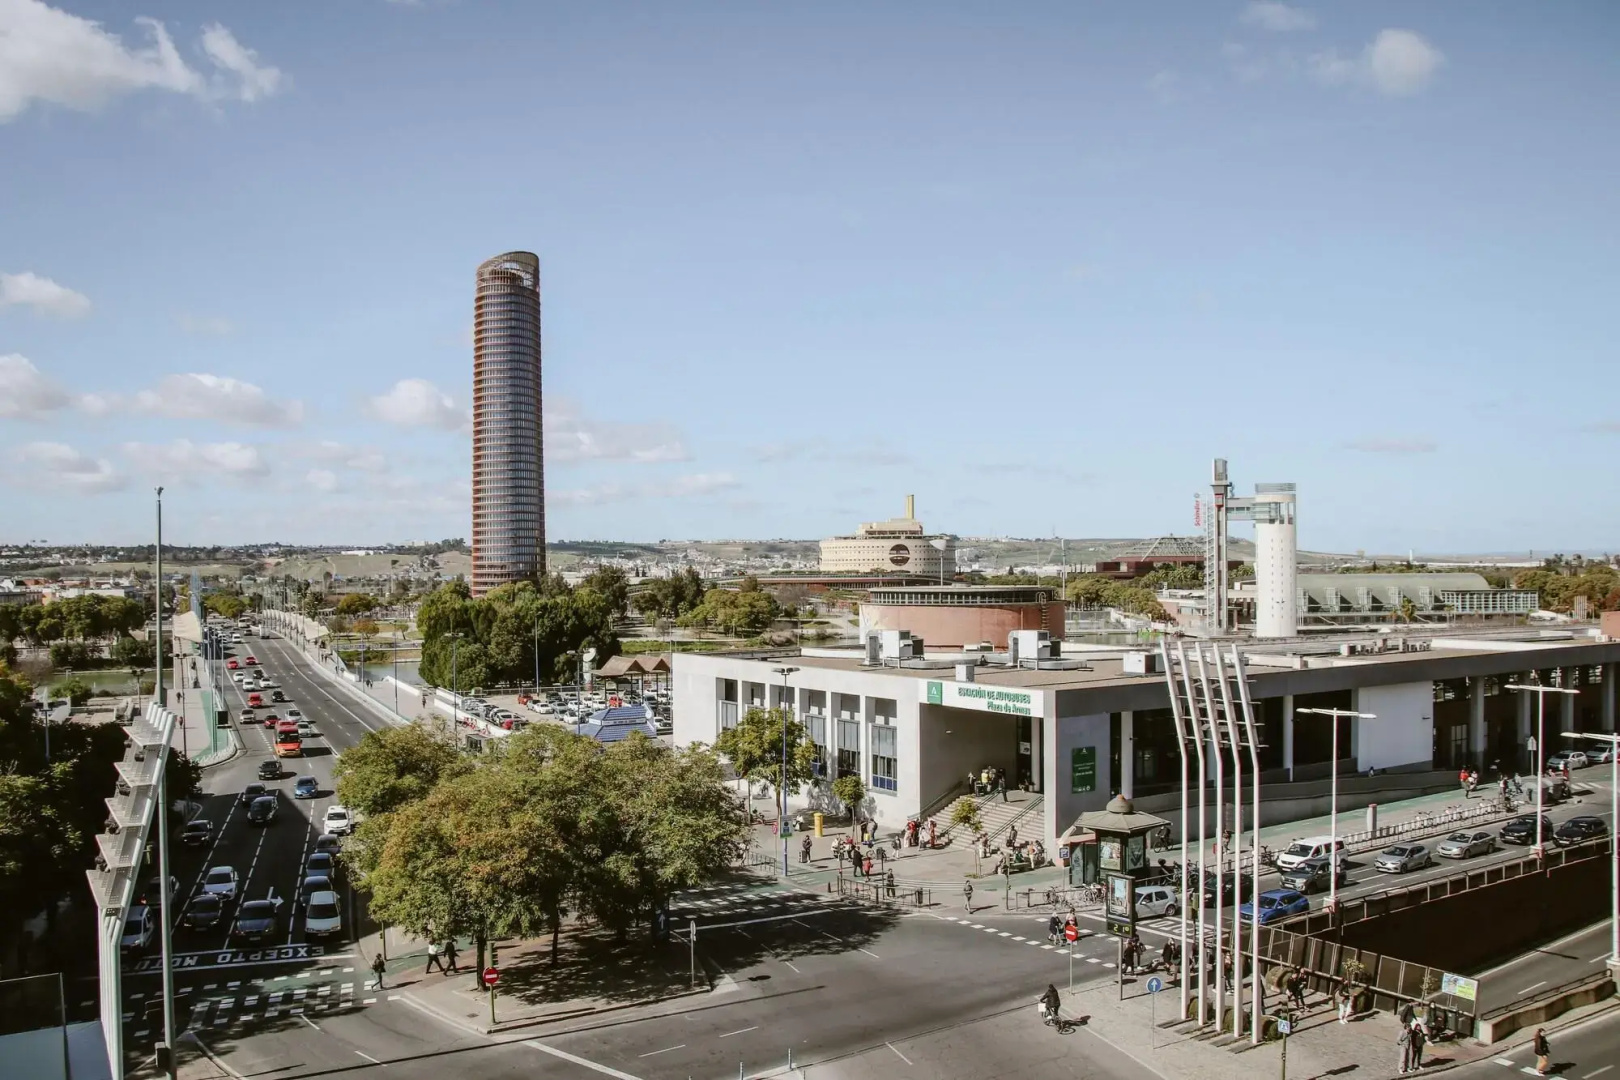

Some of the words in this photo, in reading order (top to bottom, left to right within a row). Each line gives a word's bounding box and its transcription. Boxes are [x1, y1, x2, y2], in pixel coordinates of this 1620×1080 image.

[987, 690, 995, 700] DE
[995, 691, 1031, 704] AUTOBUSES
[987, 701, 1003, 711] Plaza
[1004, 703, 1011, 713] de
[1012, 704, 1031, 715] Armas
[217, 946, 324, 963] EXCEPTO
